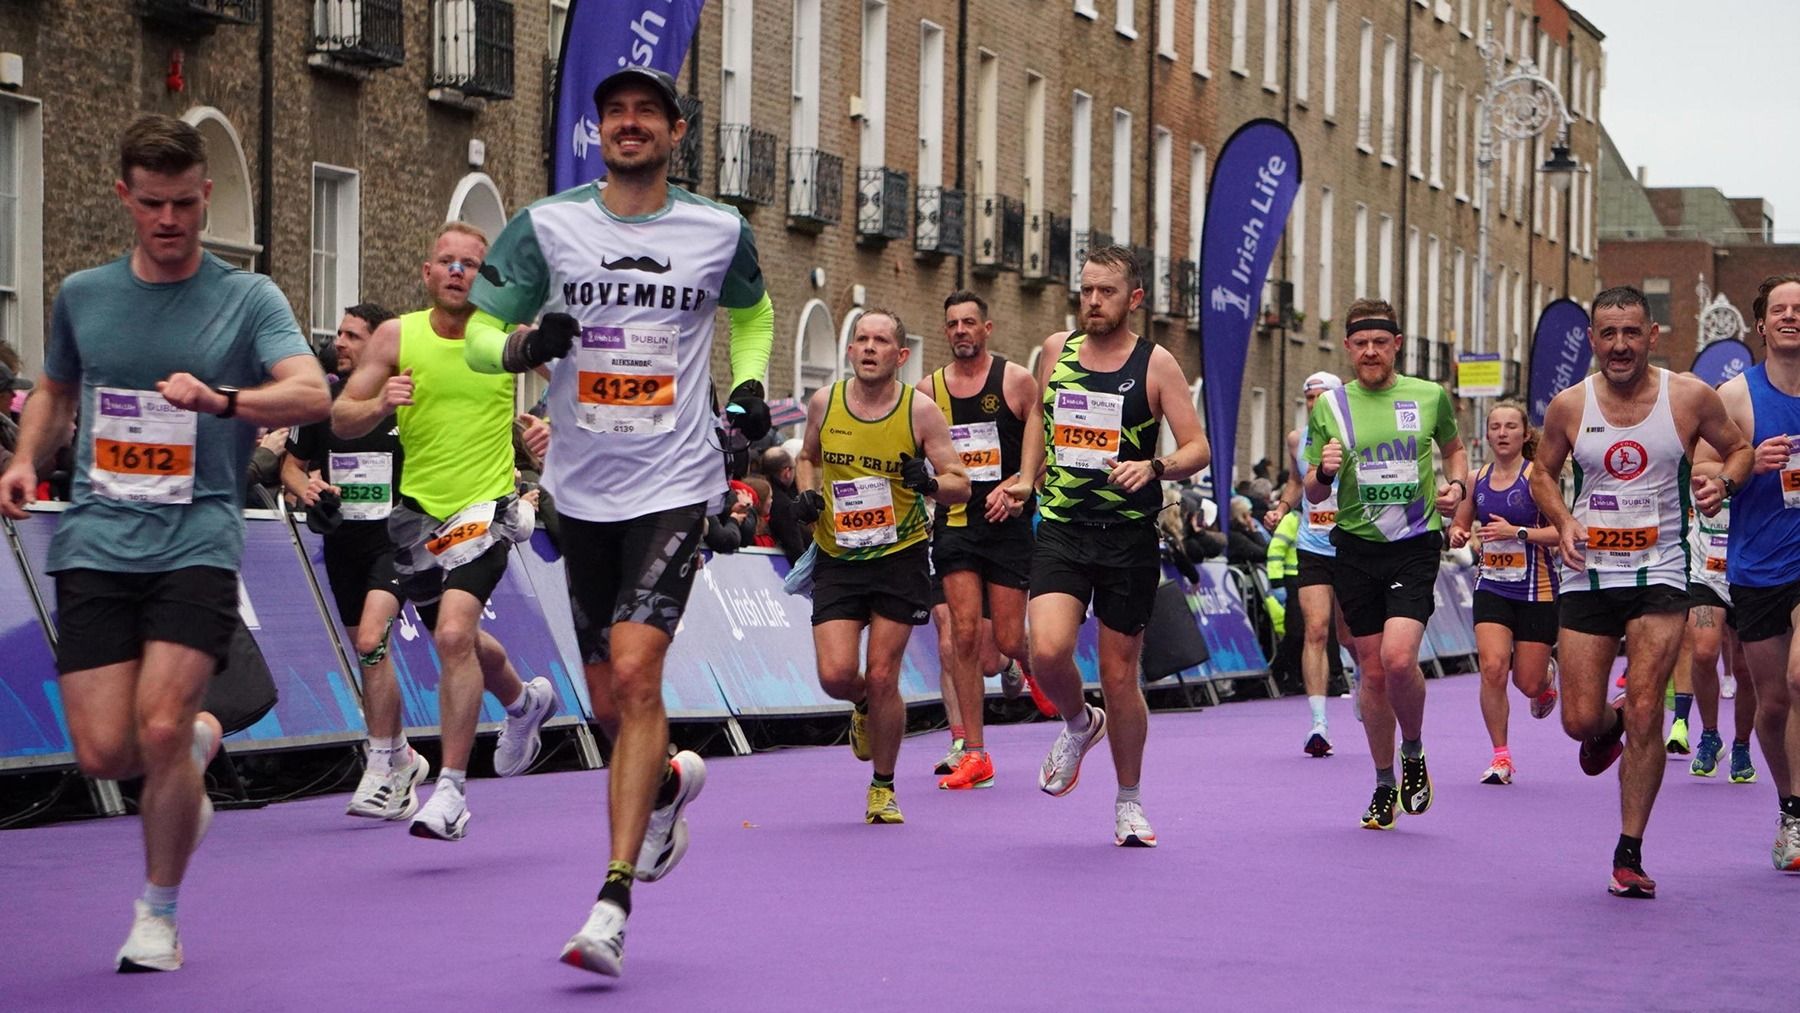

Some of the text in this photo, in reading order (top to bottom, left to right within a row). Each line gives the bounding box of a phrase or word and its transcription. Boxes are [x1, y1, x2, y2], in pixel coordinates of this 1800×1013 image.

[1231, 155, 1287, 285] Irish Life
[563, 282, 706, 312] MOVEMBER
[631, 334, 669, 345] DUBLIN
[1561, 325, 1586, 364] Life
[611, 358, 653, 367] ALEKSANDAR
[592, 377, 660, 400] 4139
[613, 425, 635, 433] 4139
[1063, 428, 1108, 447] 1596
[109, 445, 175, 471] 1612
[823, 450, 855, 466] KEEP
[885, 460, 904, 473] LI
[341, 486, 383, 500] 8528
[1366, 485, 1412, 501] 8646
[842, 509, 887, 528] 4693
[1596, 530, 1648, 548] 2255
[1490, 554, 1514, 566] 919
[724, 588, 791, 628] Irish Life
